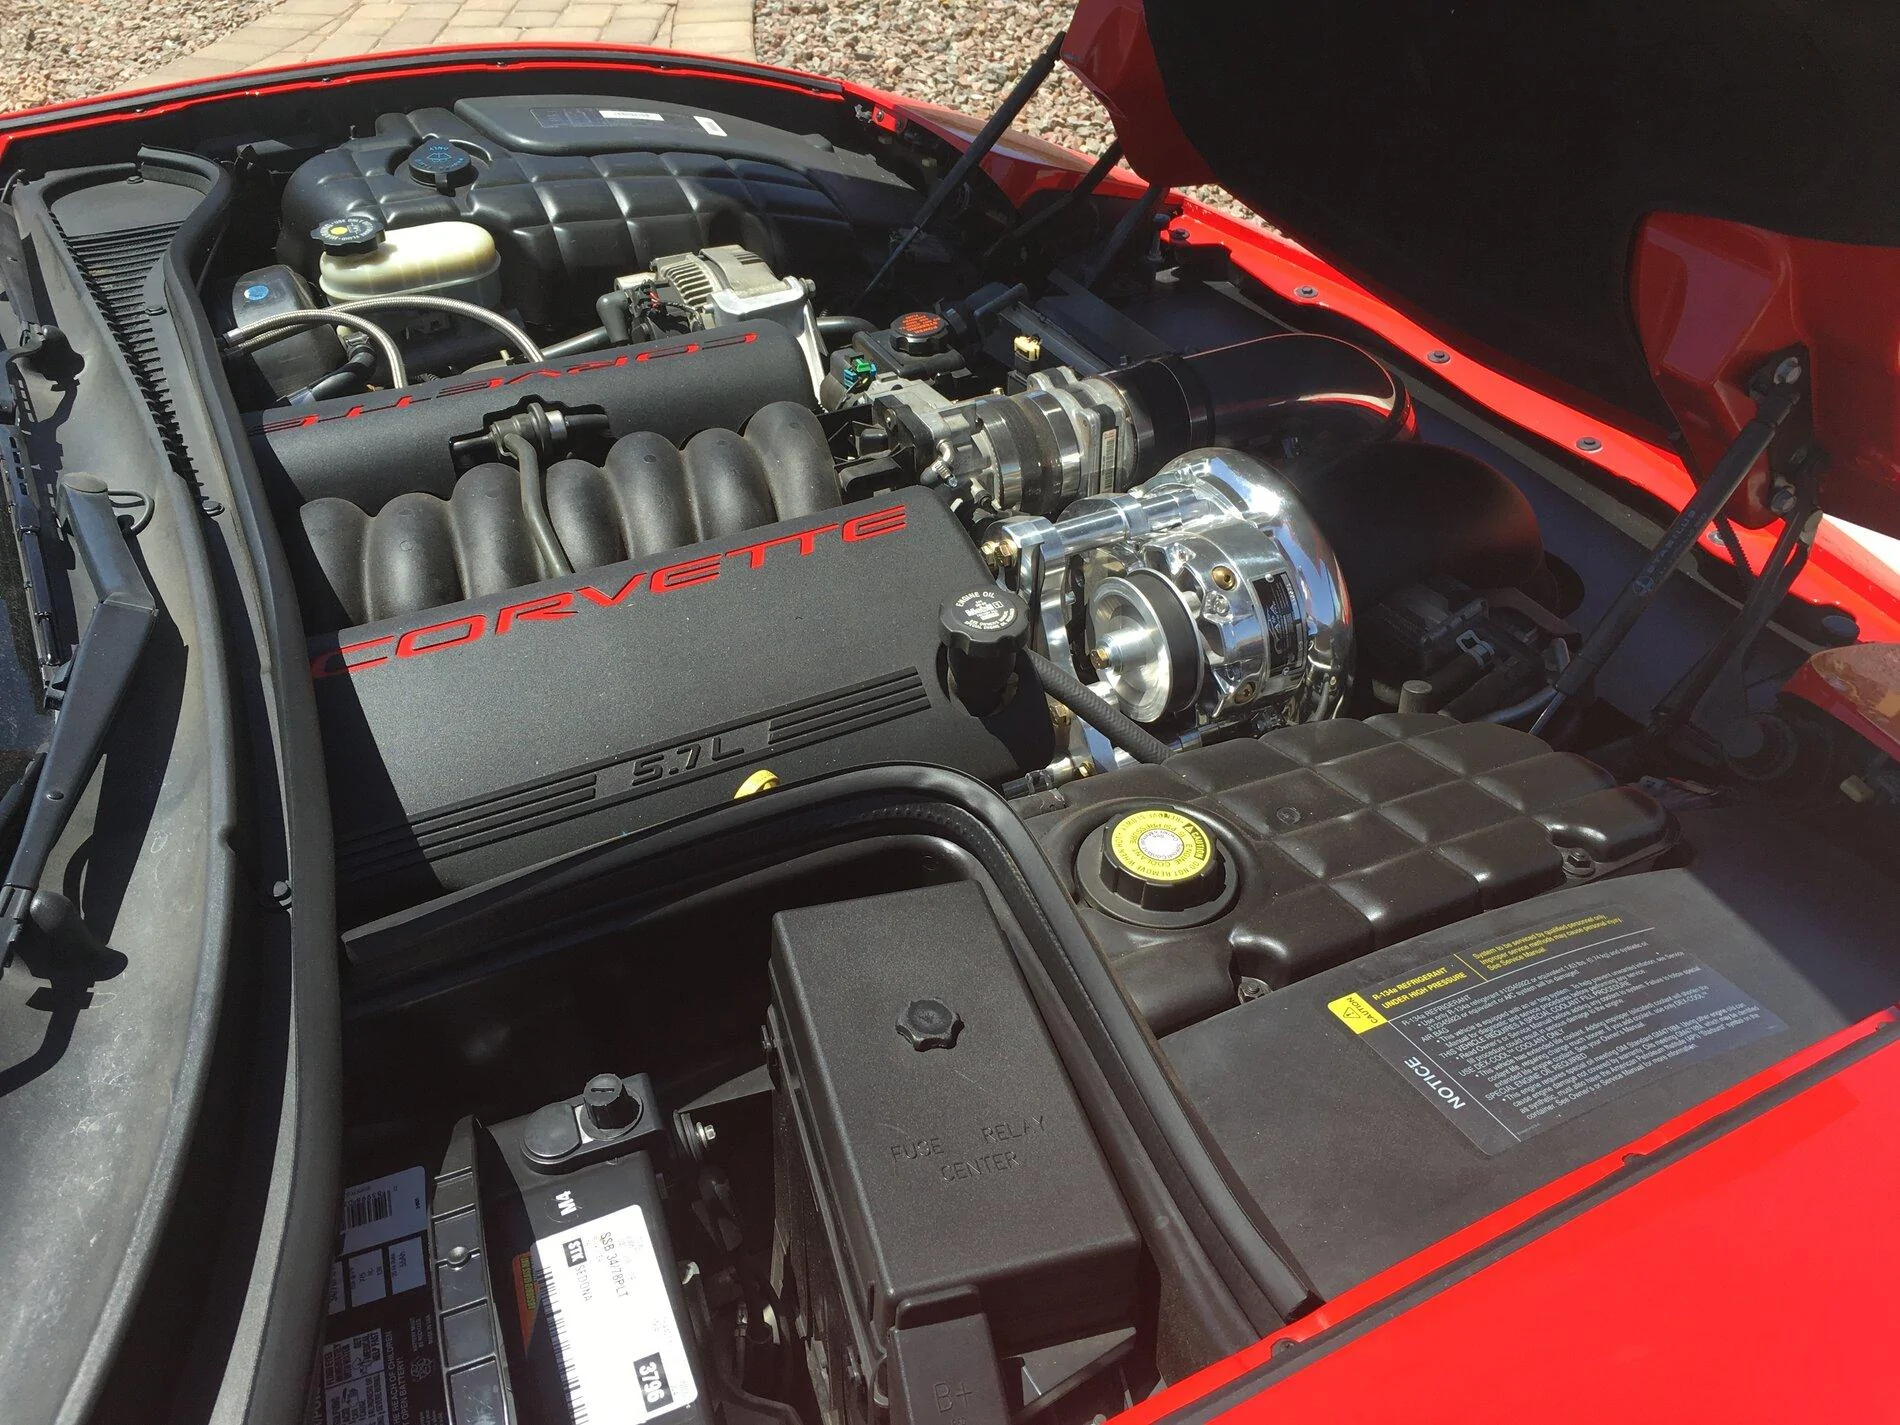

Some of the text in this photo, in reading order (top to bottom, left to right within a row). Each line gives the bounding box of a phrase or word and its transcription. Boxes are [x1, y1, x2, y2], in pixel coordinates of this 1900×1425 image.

[311, 504, 907, 678] CORVETTE
[955, 591, 980, 607] ENGINE
[982, 591, 995, 599] OIL
[631, 735, 747, 787] 5.7L
[1191, 831, 1205, 861] CAUTION
[1137, 865, 1171, 877] REMOVE
[1370, 967, 1449, 1000] R-134a REFRIGERANT
[1381, 971, 1467, 1008] UNDER HIGH PRESSURE
[1344, 997, 1379, 1023] CAUTION
[1423, 994, 1473, 1016] REFRIGERANT
[1419, 1026, 1450, 1042] AIR BAG
[1454, 1036, 1487, 1051] VEHICLE
[1457, 1066, 1476, 1076] USE
[1513, 1035, 1549, 1052] COOLANT
[1545, 1028, 1566, 1039] ONLY
[1402, 1056, 1467, 1109] NOTICE
[1483, 1083, 1516, 1100] SPECIAL
[1513, 1072, 1543, 1087] ENGINE
[1539, 1067, 1555, 1076] OIL
[890, 1114, 1048, 1163] FUSE RELAY
[940, 1151, 1022, 1182] CENTER
[555, 1190, 577, 1217] M4
[600, 1231, 615, 1252] SSB
[567, 1240, 593, 1301] STK SEDONA
[384, 1331, 396, 1369] CHILDREN
[388, 1370, 396, 1382] OF
[396, 1356, 409, 1421] OPEN BATTERY!
[638, 1361, 665, 1403] 3796
[389, 1381, 400, 1411] REACH
[934, 1382, 974, 1413] B+
